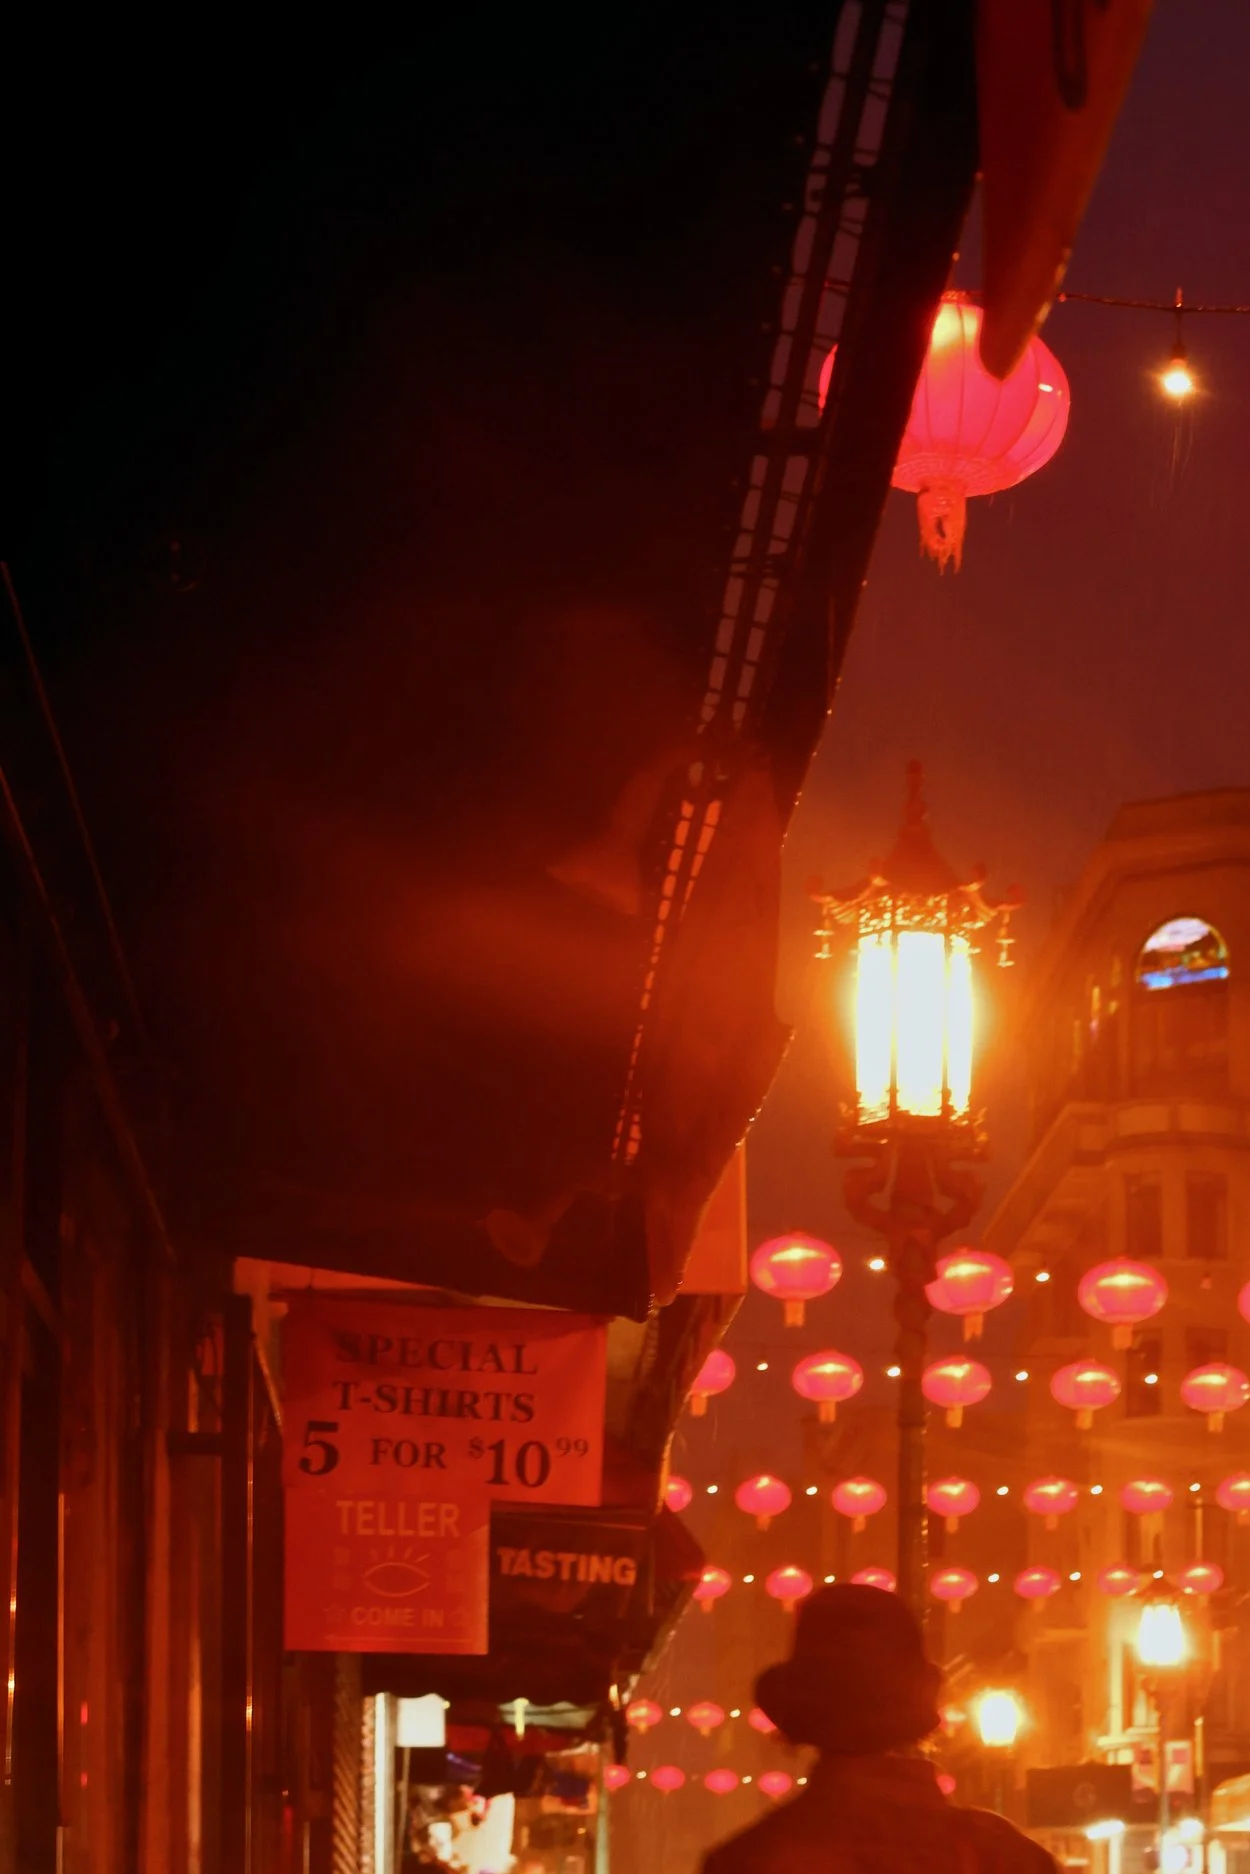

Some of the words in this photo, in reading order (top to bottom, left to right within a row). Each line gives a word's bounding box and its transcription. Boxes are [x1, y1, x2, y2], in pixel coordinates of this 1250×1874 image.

[333, 1332, 537, 1376] SPECIAL
[332, 1380, 535, 1424] T-SHIRTS
[298, 1420, 340, 1476] 5
[370, 1438, 447, 1470] FOR
[336, 1499, 461, 1538] TELLER
[497, 1546, 637, 1586] TASTING
[350, 1605, 416, 1627] COME
[421, 1607, 445, 1628] IN
